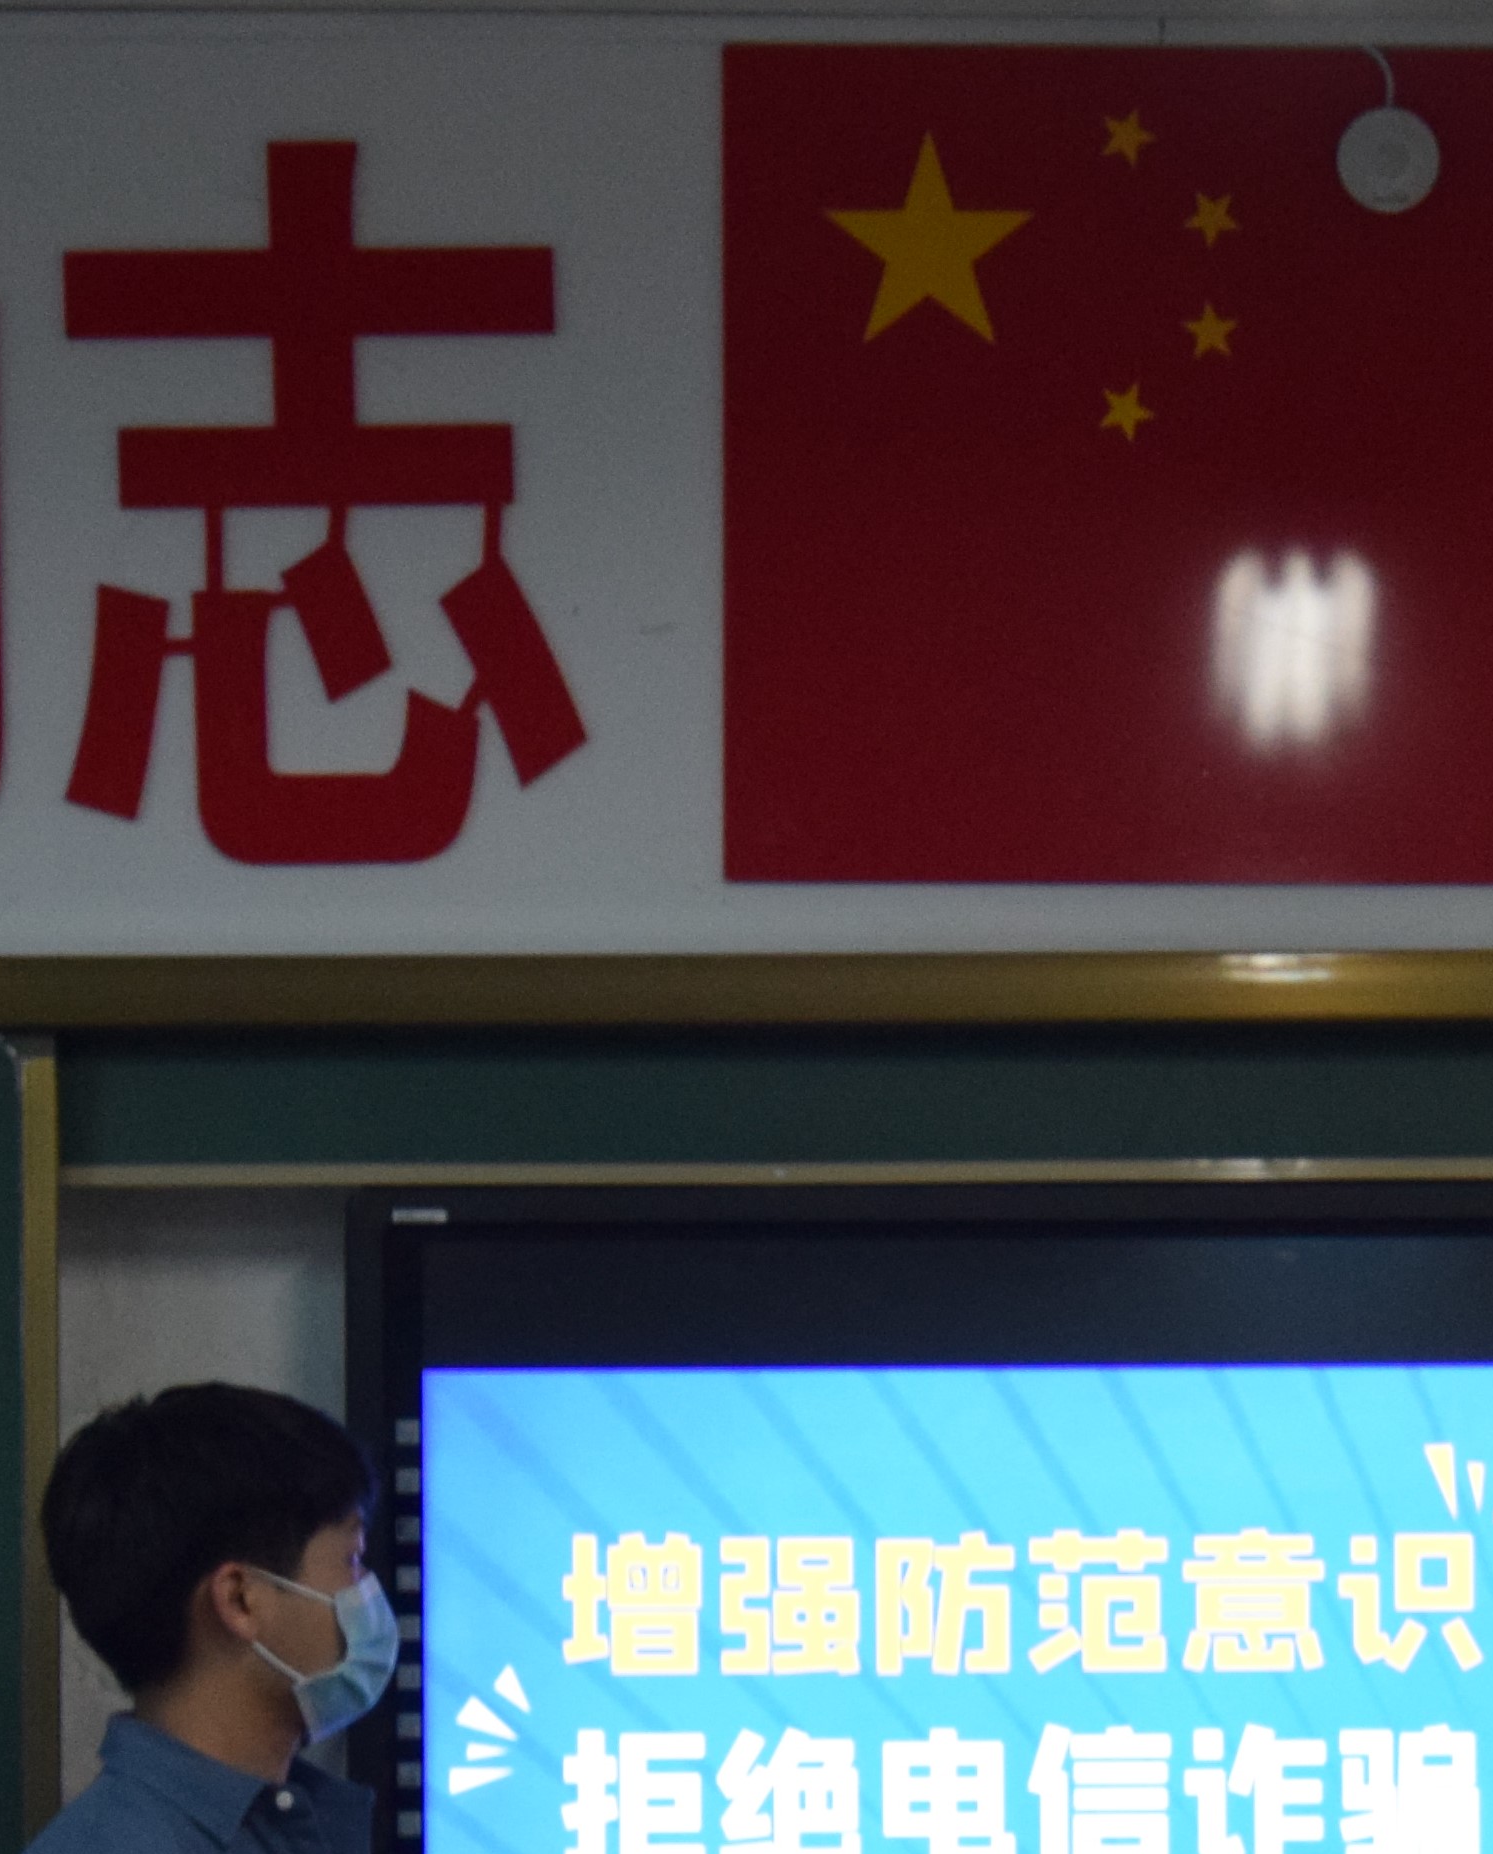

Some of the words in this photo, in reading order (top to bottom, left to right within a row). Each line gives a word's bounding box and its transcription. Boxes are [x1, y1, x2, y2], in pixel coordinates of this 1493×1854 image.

[562, 1529, 1483, 1675] 增强防范意识
